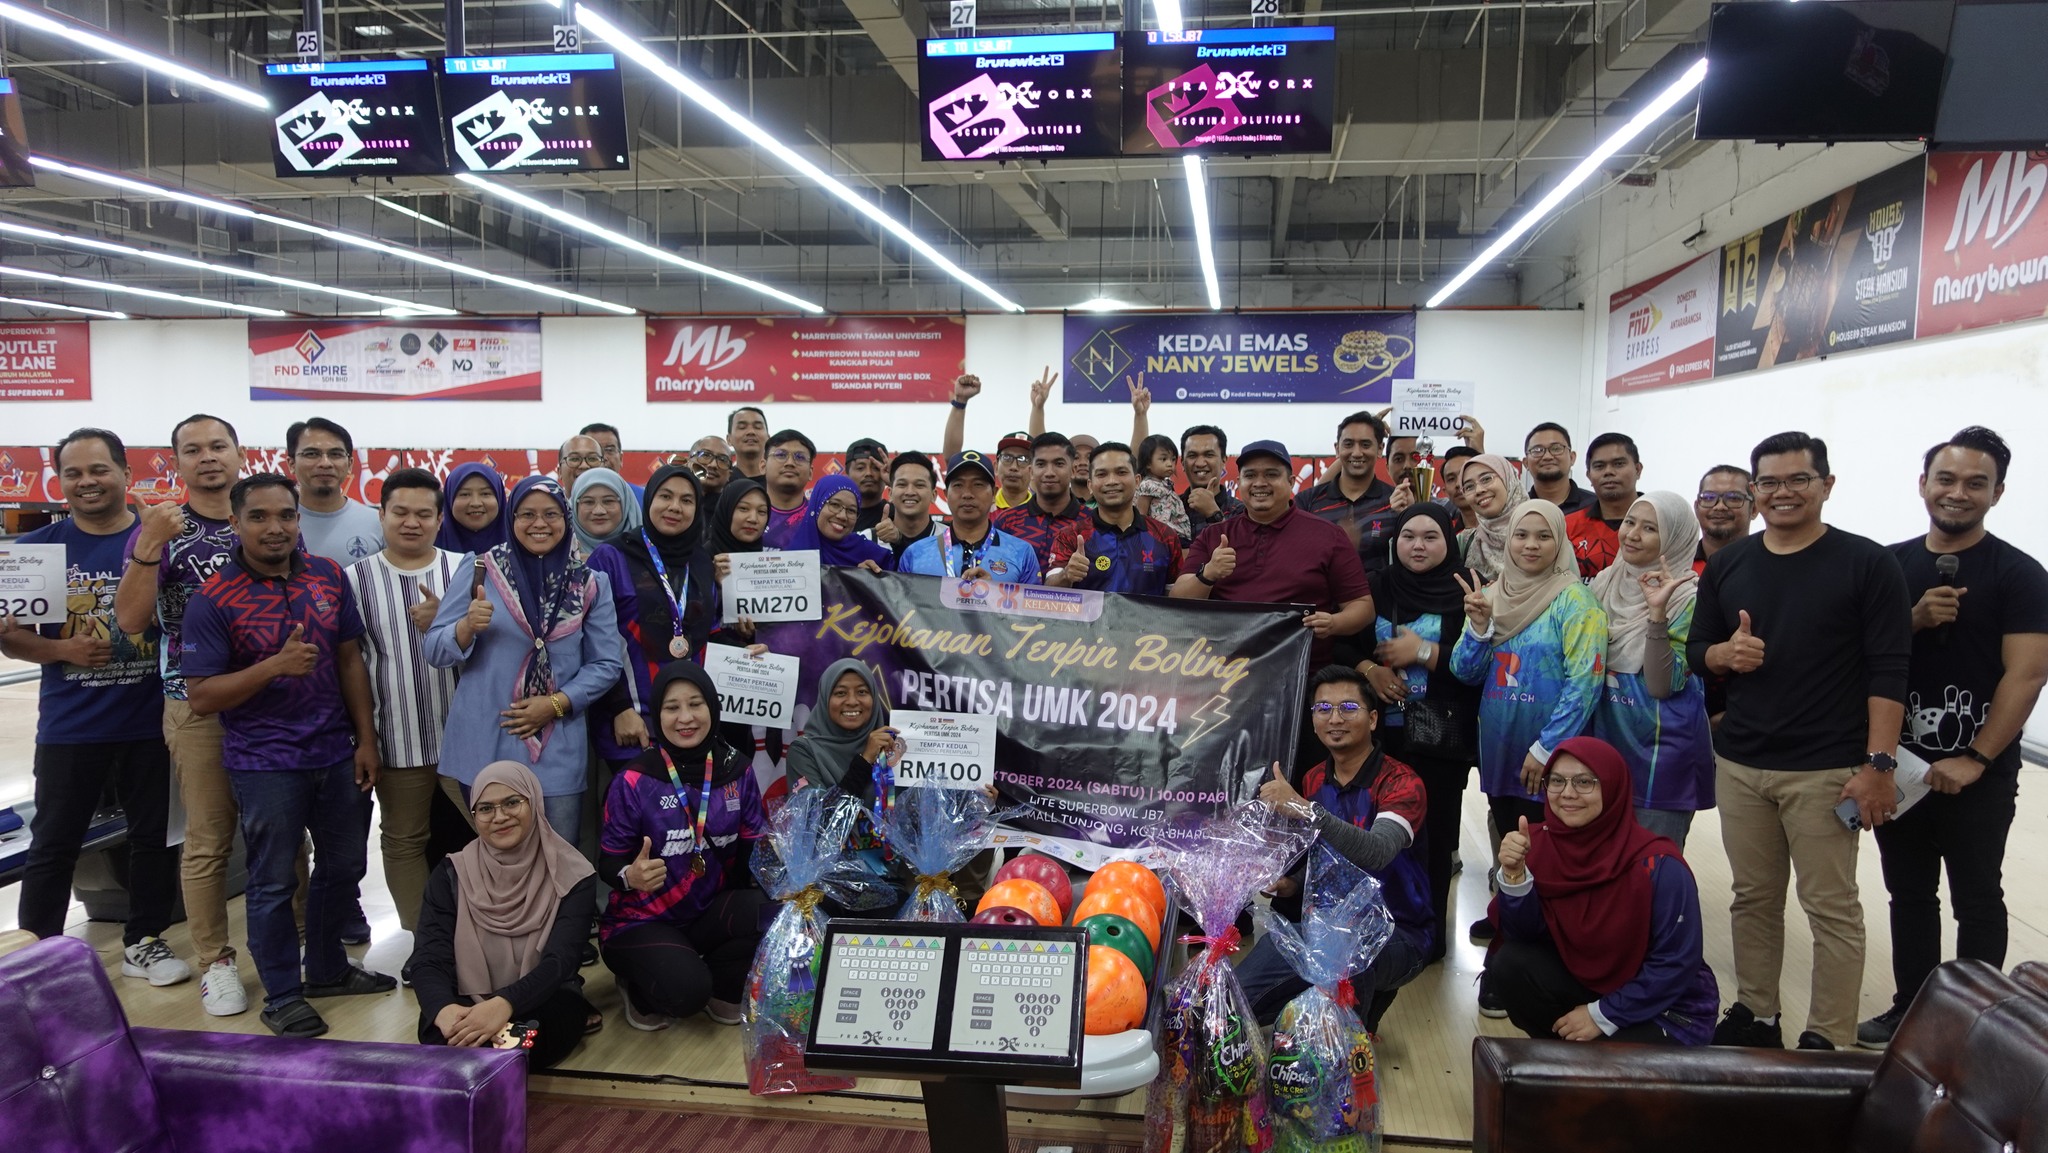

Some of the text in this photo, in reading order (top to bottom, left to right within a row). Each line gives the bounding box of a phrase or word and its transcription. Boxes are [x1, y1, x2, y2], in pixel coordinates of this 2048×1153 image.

[952, 5, 974, 25] 27
[299, 34, 317, 52] 25
[555, 29, 577, 48] 26
[1197, 44, 1273, 58] Brunswick
[976, 54, 1051, 68] Brunswick
[310, 74, 374, 87] Brunswick
[491, 73, 558, 85] Brunswick
[1174, 114, 1301, 126] SCORING SOLUTIONS
[1869, 201, 1902, 233] HOUSE
[1873, 228, 1893, 264] 89
[1729, 258, 1736, 293] 1
[1746, 253, 1756, 289] 2
[1856, 278, 1875, 301] STEAK
[1875, 266, 1908, 296] MANSION
[1676, 288, 1697, 305] DOMESTIK
[1670, 312, 1702, 331] ANTARABANGSA
[1836, 319, 1907, 342] HOUSE89 STEAK MANSION
[46, 327, 56, 335] JB
[801, 332, 942, 341] MARRYBROWN TAMAN UNIVERSITI
[663, 325, 747, 371] Mb
[1158, 333, 1308, 352] KEDAI EMAS
[1626, 336, 1660, 361] EXPRESS
[12, 356, 56, 370] LANE
[801, 350, 920, 358] MARRYBROWN BANDAR BARU
[829, 359, 893, 367] KANGKAR PULAI
[274, 365, 348, 376] FND EMPIRE
[1147, 355, 1319, 373] NANY JEWELS
[1675, 359, 1710, 375] FND EXPRESS HQ
[655, 376, 755, 394] Marrybrown
[801, 373, 931, 381] MARRYBROWN SUNWAY BIG BOX
[831, 382, 902, 390] ISKANDAR PUTERI
[7, 389, 64, 397] SUPERBOWL JB
[1188, 391, 1219, 399] nanyjewels
[1261, 391, 1275, 399] Nany
[1399, 416, 1464, 431] RM400
[956, 597, 988, 606] PERTISA
[1025, 590, 1055, 600] Universiti
[736, 595, 808, 614] RM270
[1024, 600, 1080, 614] KELANTAN
[816, 602, 1250, 694] Kejohanan Tenpin Boling
[728, 675, 778, 688] TEMPAT PERTAMA
[717, 693, 782, 719] RM150
[901, 669, 1178, 735] PERTISA UMK 2024
[899, 760, 982, 782] RM100
[1047, 777, 1083, 792] 2024
[1087, 782, 1145, 801] (SABTU)
[1157, 789, 1200, 803] 10.00
[1029, 796, 1167, 822] LITE SUPERBOWL JB7,
[1061, 814, 1127, 837] TUNJONG,
[1270, 1063, 1317, 1085] Chipster
